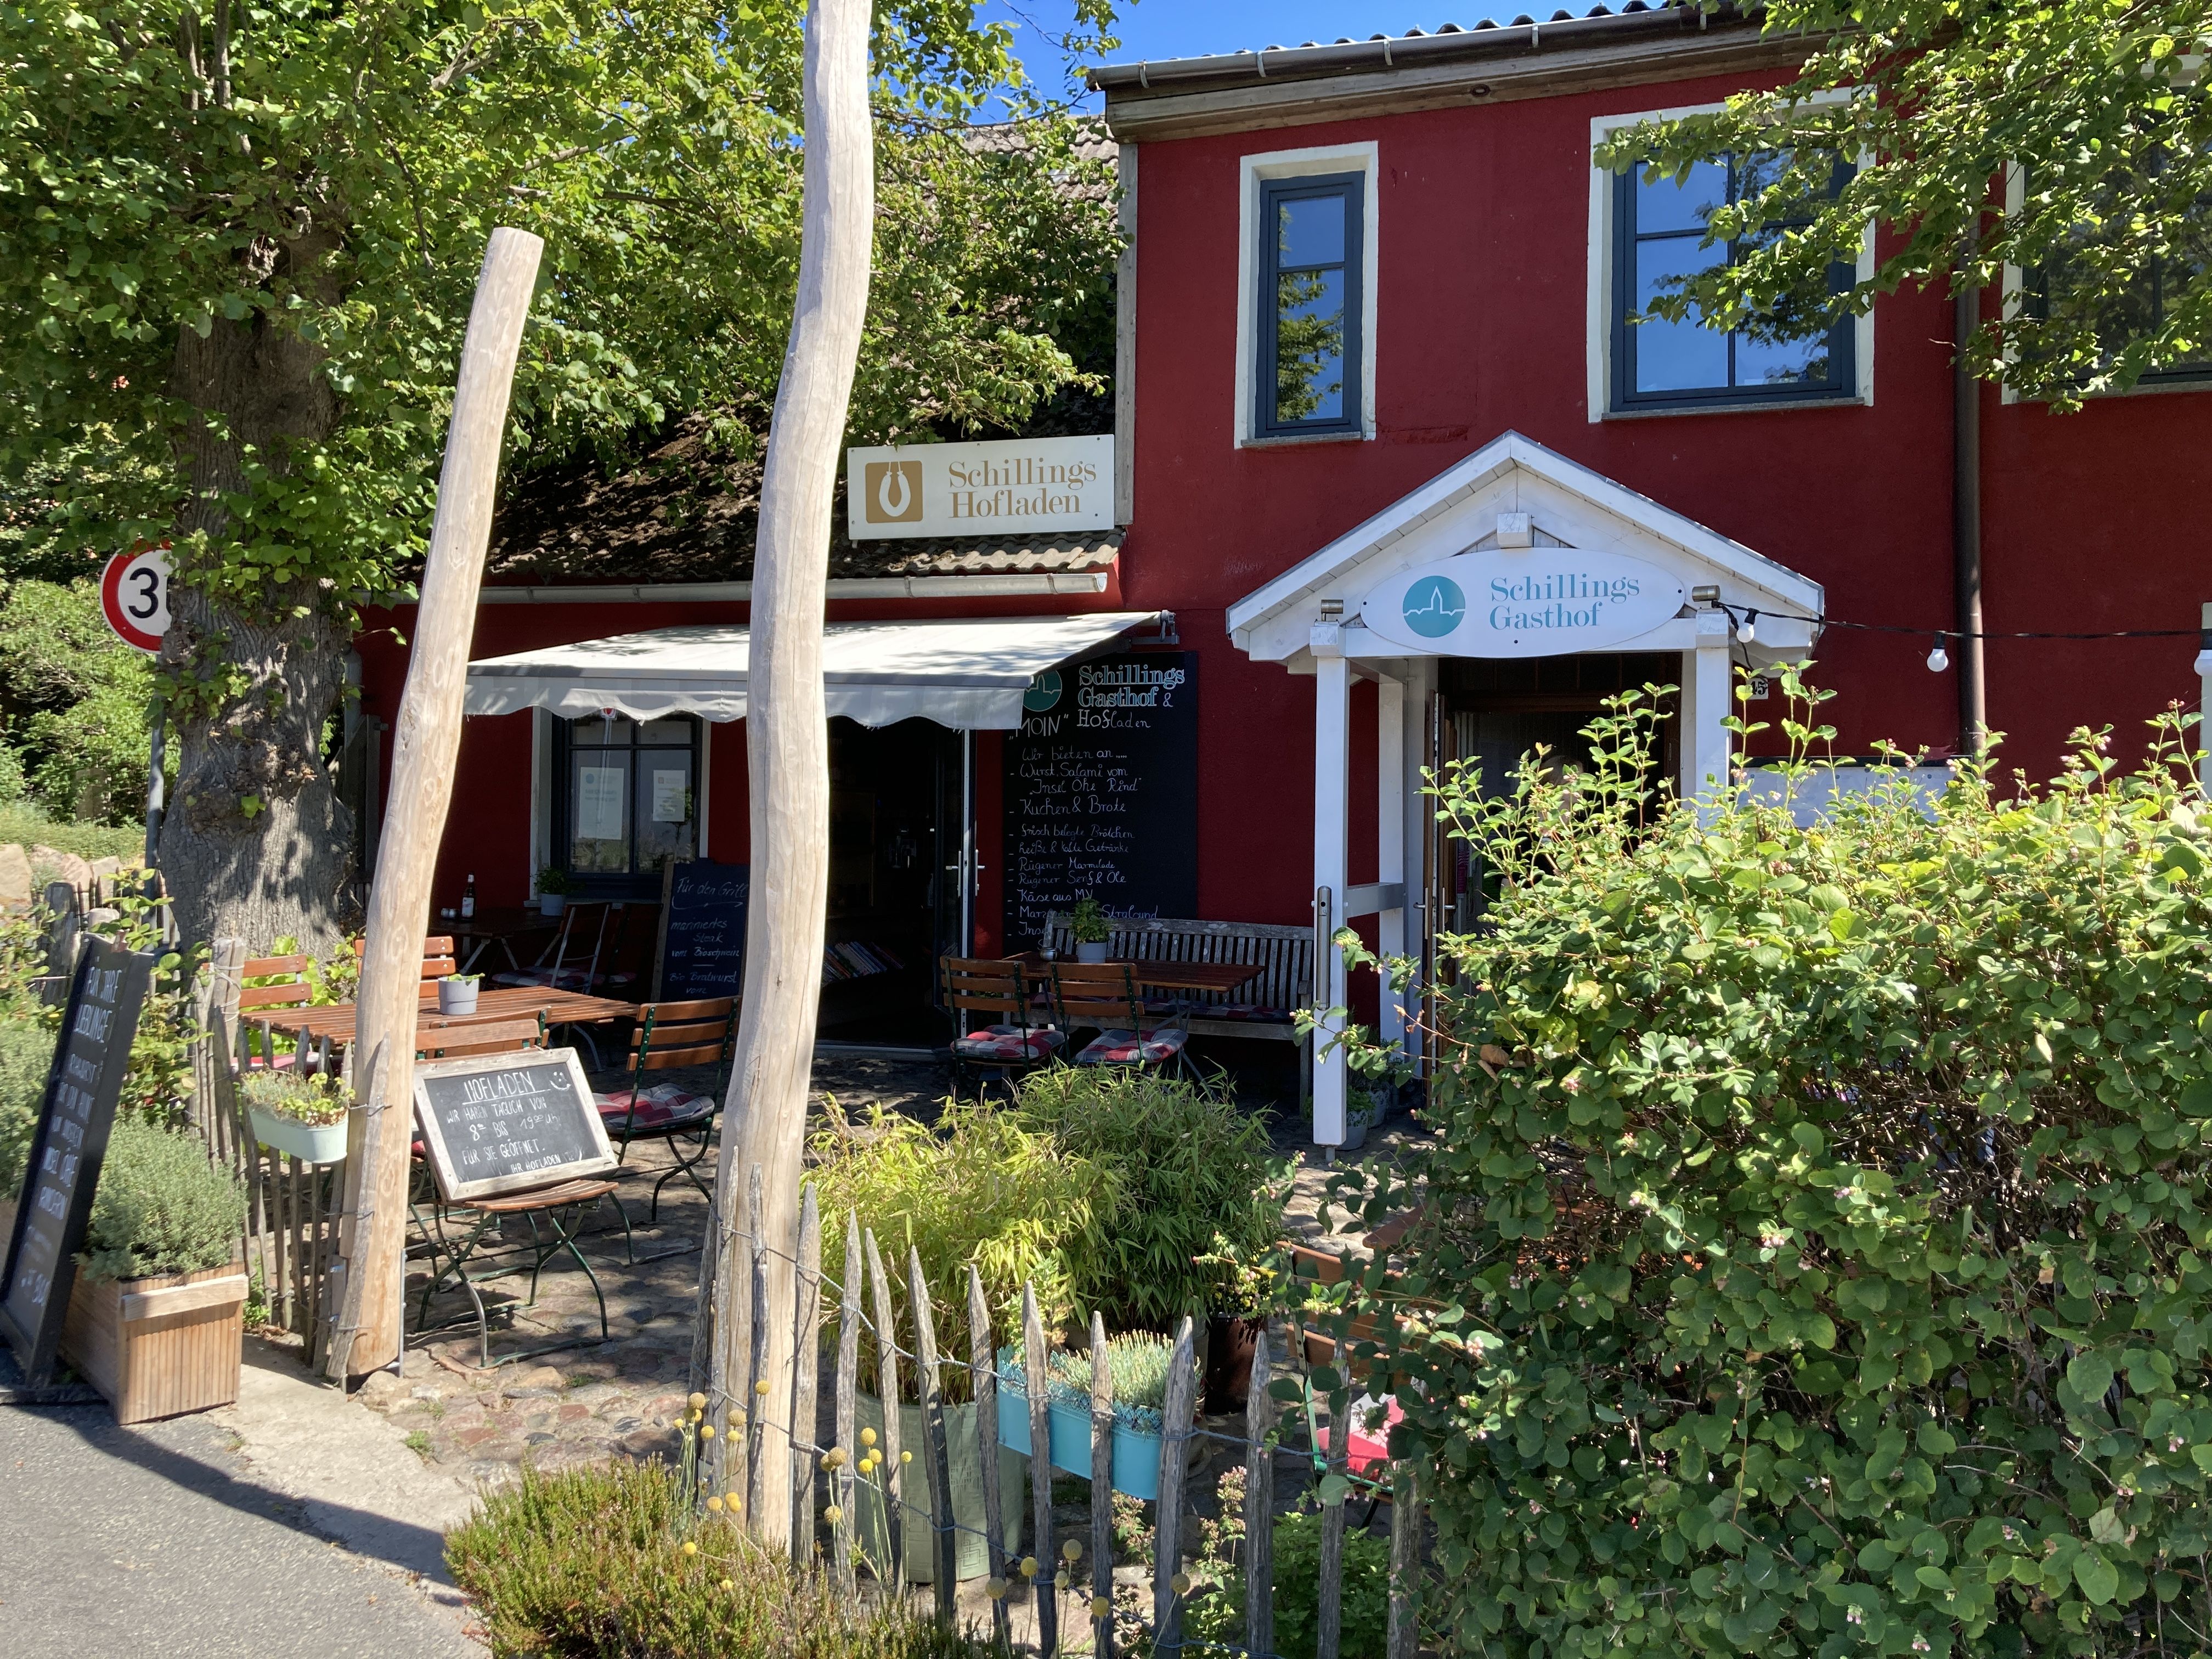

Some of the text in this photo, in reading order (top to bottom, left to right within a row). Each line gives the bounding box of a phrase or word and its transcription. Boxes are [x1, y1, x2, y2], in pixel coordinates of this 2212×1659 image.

[948, 457, 1096, 490] Schillings
[948, 488, 1082, 518] Hofladen
[128, 567, 172, 618] 3
[1491, 573, 1640, 604] Schillings
[1489, 601, 1602, 630] Gasthof
[1079, 664, 1185, 690] Schillings
[1077, 686, 1173, 708] Gasthof &
[1076, 709, 1152, 729] Hofladen
[1022, 747, 1043, 760] Wir
[1051, 744, 1093, 760] bieten
[1060, 762, 1103, 777] Salami
[1107, 768, 1128, 777] vom
[1019, 795, 1126, 815] Kuchen & Brote
[1022, 823, 1135, 840] frisch belegte Brötchen
[1019, 840, 1047, 855] heiße
[1050, 841, 1057, 853] &
[1085, 839, 1128, 853] Getränke
[1018, 857, 1115, 875] Rügener Marmelade
[697, 879, 715, 895] den
[718, 882, 748, 898] Grill
[1018, 872, 1060, 888] Rügener
[1095, 871, 1103, 883] &
[1017, 889, 1049, 902] Käse
[693, 933, 724, 944] Steak
[669, 970, 737, 983] Bio Bratwurst
[462, 1070, 536, 1102] HOFLADEN
[447, 1109, 460, 1124] WIR
[466, 1105, 488, 1120] HABEN
[529, 1096, 547, 1111] VON
[492, 1120, 509, 1138] BIS
[461, 1146, 481, 1165] FÜR
[483, 1146, 498, 1161] SIE
[510, 1163, 523, 1173] IHR
[525, 1154, 561, 1171] HOFLADEN
